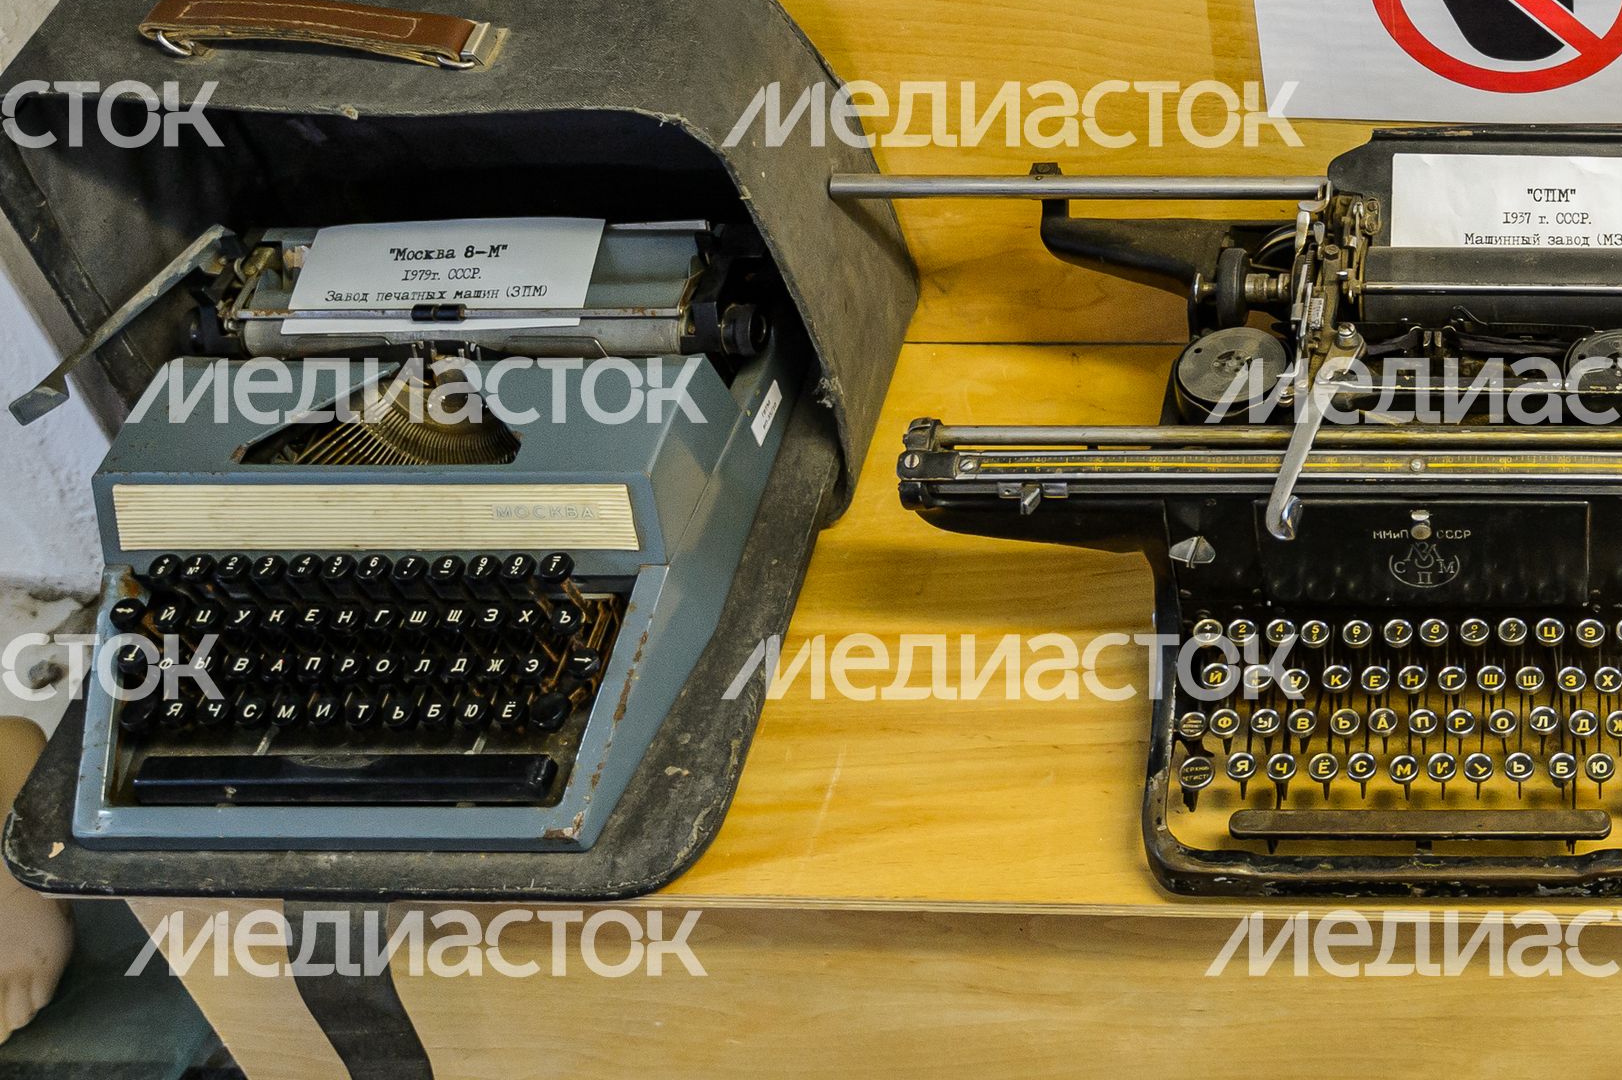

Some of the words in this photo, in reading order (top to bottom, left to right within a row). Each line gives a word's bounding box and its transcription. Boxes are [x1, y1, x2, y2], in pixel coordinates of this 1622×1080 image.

[1526, 187, 1577, 204] "СПМ"
[1555, 211, 1592, 225] СССР.
[1463, 231, 1541, 247] Машинный
[1547, 233, 1590, 247] завод
[389, 246, 457, 262] "Москва
[447, 266, 482, 281] СССР.
[324, 290, 369, 303] Завод
[375, 287, 447, 302] печатных
[453, 286, 500, 300] машин
[505, 284, 548, 299] (ЗПМ)
[495, 504, 594, 520] МОСКВА
[1436, 529, 1472, 540] СССР
[160, 607, 175, 620] Й
[235, 611, 250, 623] У
[305, 609, 319, 621] Е
[338, 611, 353, 623] Н
[375, 610, 389, 622] Г
[410, 611, 426, 622] Ш
[484, 609, 498, 621] З
[519, 610, 533, 622] Х
[560, 611, 571, 623] Ъ
[167, 703, 182, 716] Я
[208, 704, 222, 717] Ч
[277, 705, 295, 718] М
[316, 704, 331, 717] И
[358, 705, 369, 718] Т
[393, 706, 404, 719] Ь
[427, 704, 441, 717] Б
[464, 704, 478, 717] Ю
[502, 701, 515, 717] Ё
